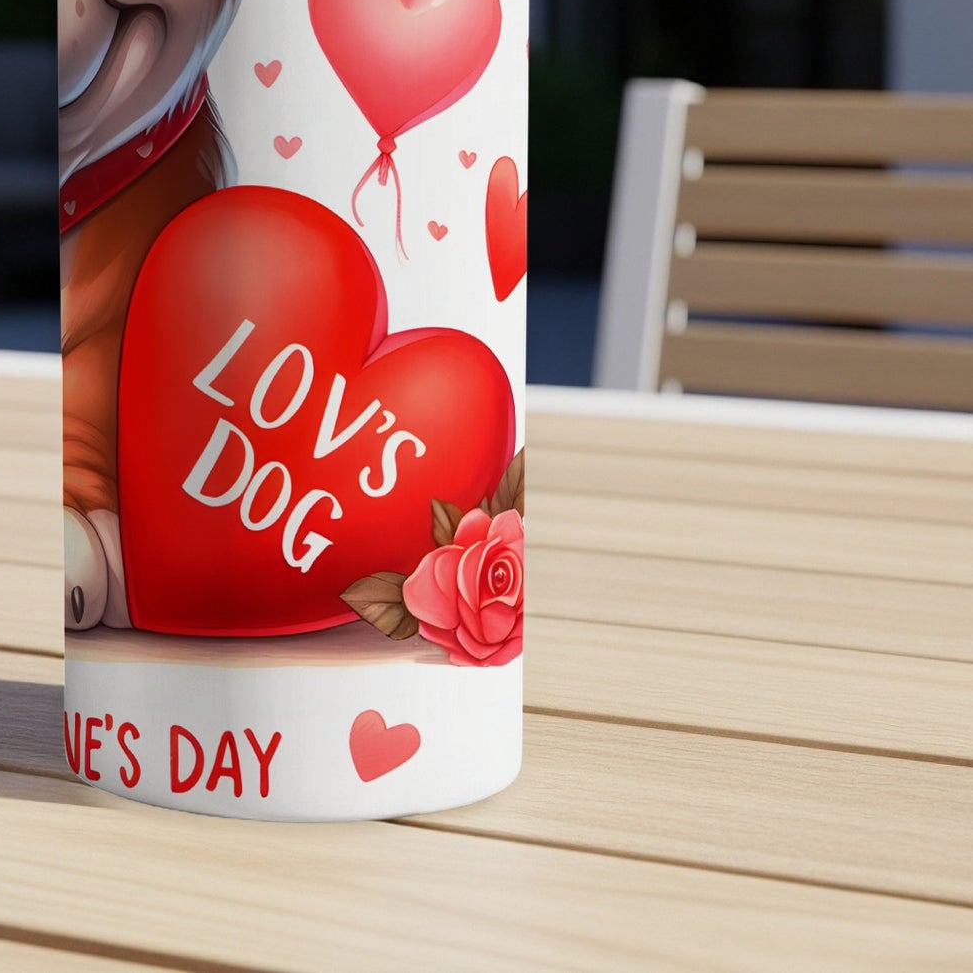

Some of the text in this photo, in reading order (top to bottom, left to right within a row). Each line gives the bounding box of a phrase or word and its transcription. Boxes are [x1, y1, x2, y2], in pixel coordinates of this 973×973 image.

[192, 318, 427, 498] LOV'S
[182, 417, 344, 574] DOG
[169, 724, 283, 798] DAY
